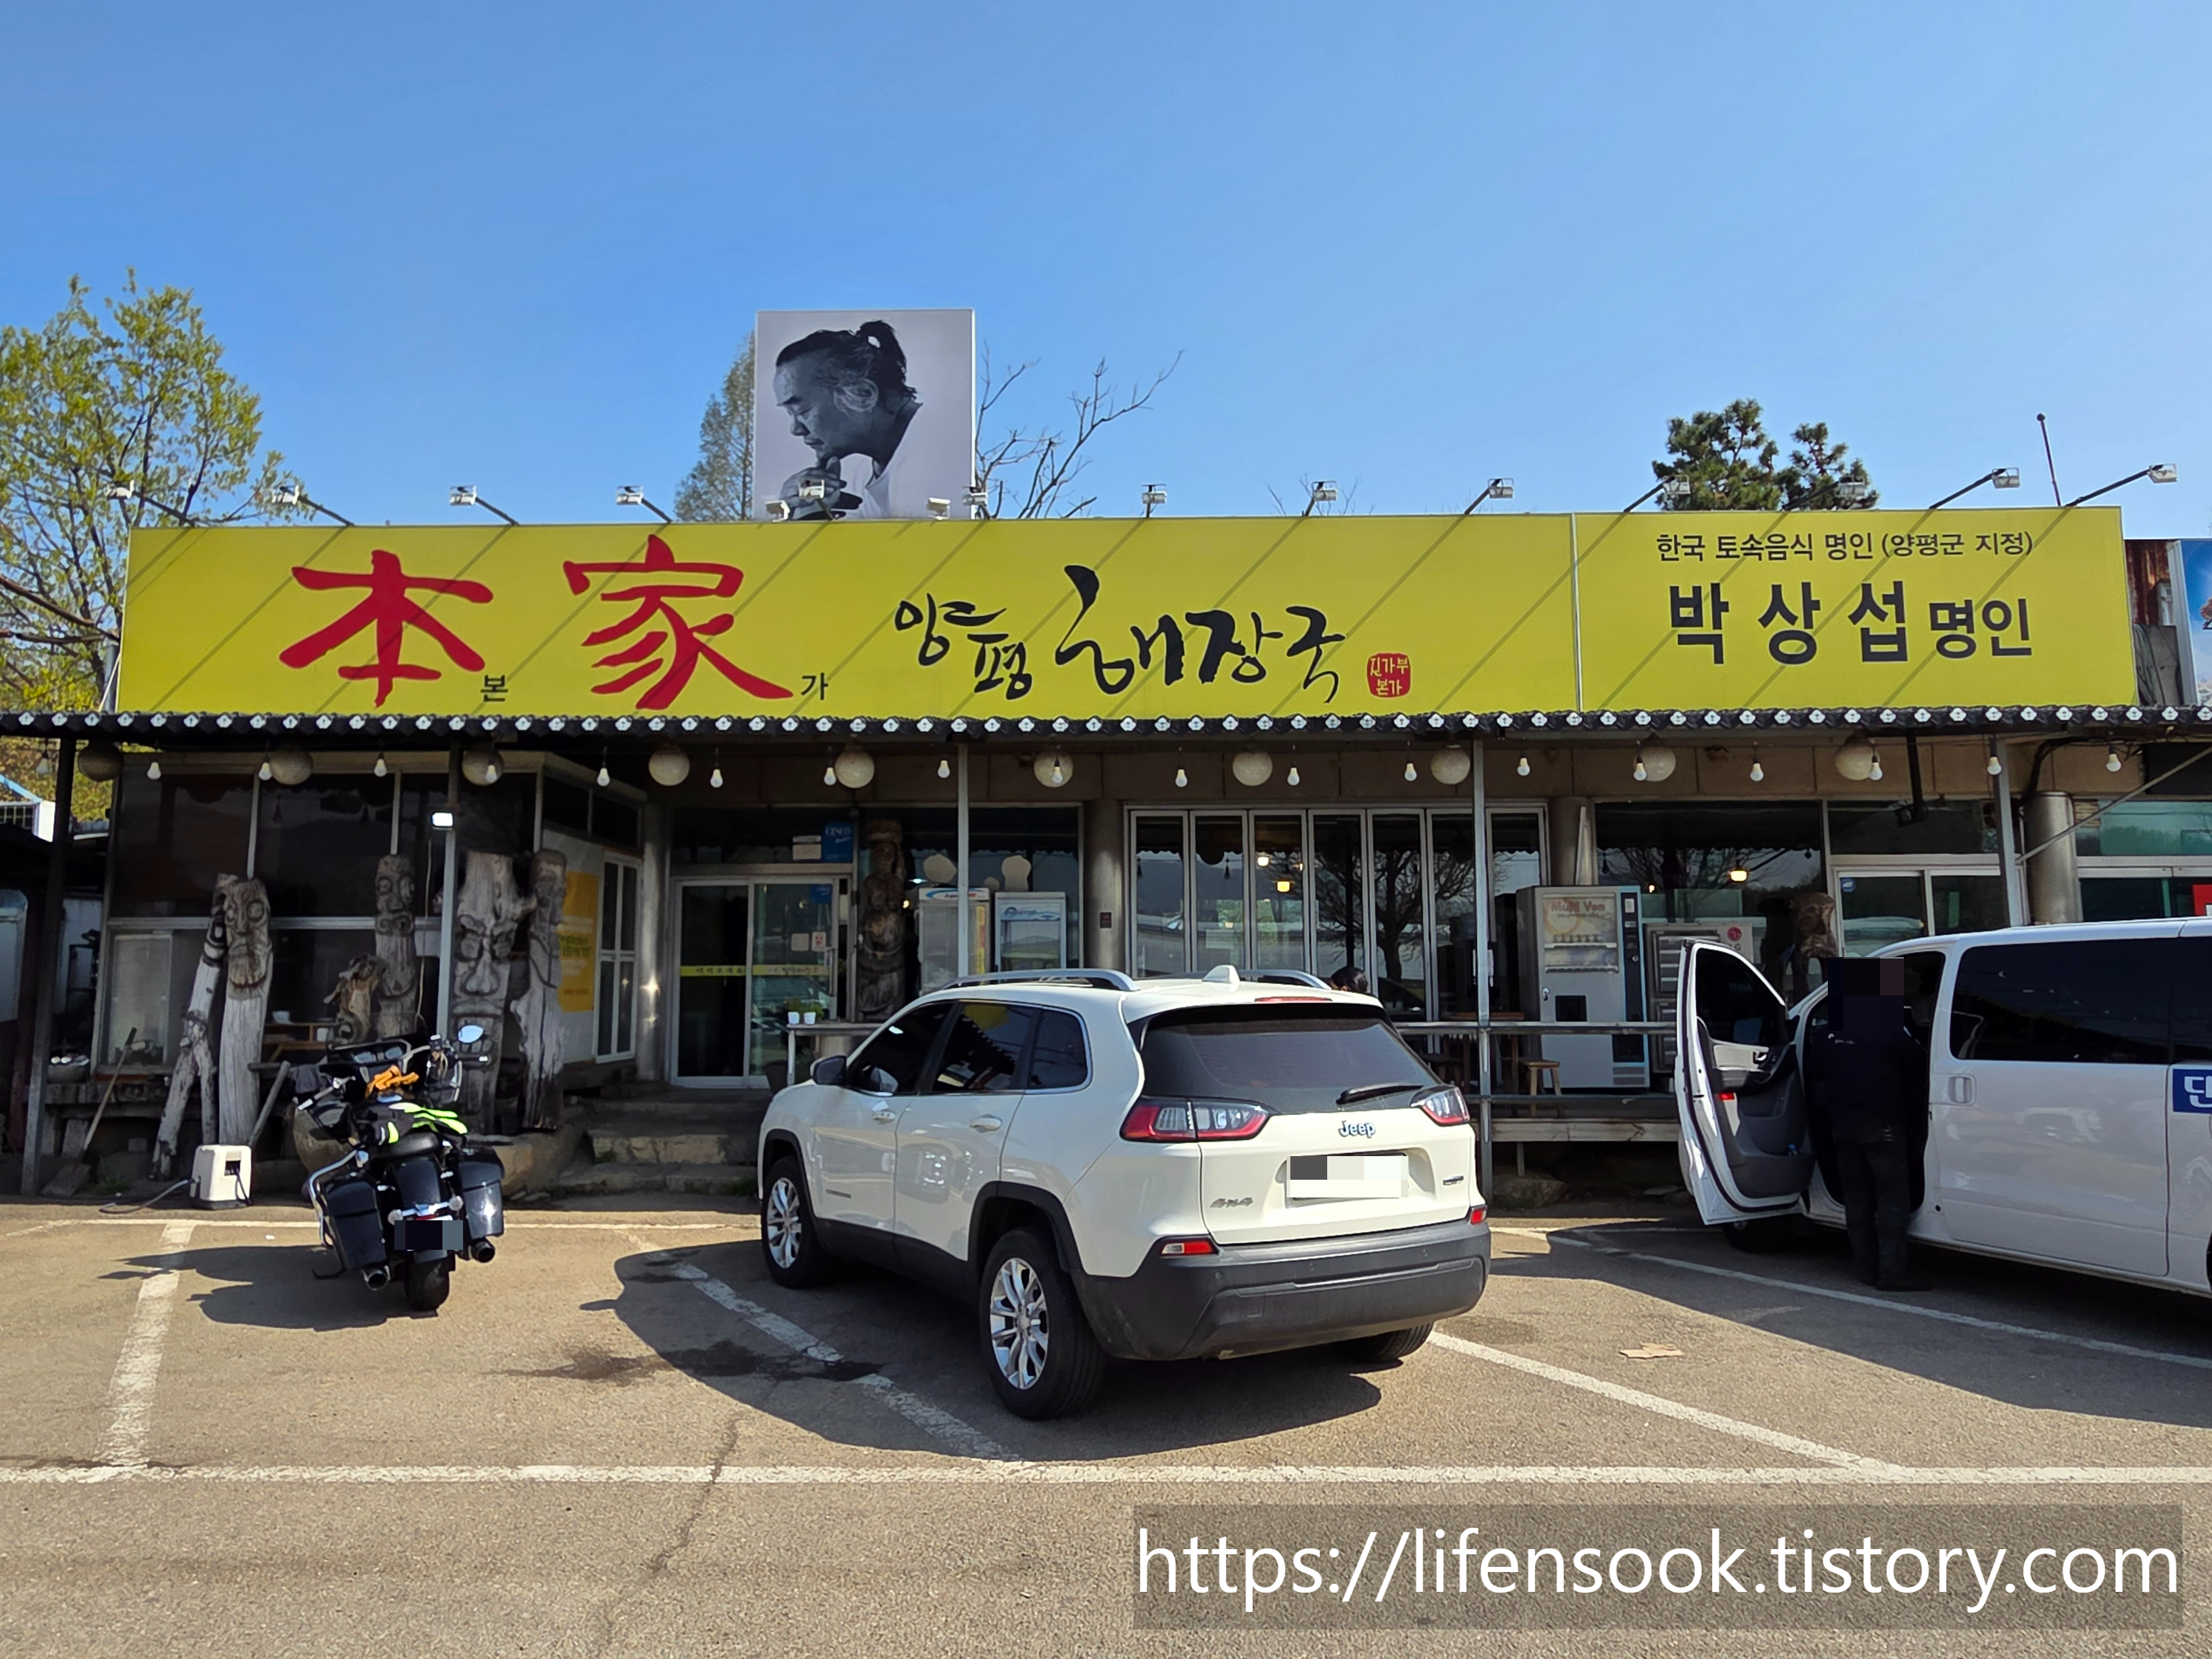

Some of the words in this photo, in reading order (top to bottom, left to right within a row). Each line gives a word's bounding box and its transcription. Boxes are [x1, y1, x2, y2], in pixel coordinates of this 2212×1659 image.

[1656, 534, 1705, 562] 한국
[1715, 533, 1813, 562] 토속음식
[1825, 532, 1874, 560] 명인
[1882, 533, 1966, 558] (양평군
[1975, 531, 2033, 556] 지정)
[1929, 598, 2032, 659] 명인
[481, 675, 508, 702] 본
[801, 672, 829, 700] 가
[1376, 678, 1403, 695] 본가
[1338, 1120, 1377, 1139] Jeep
